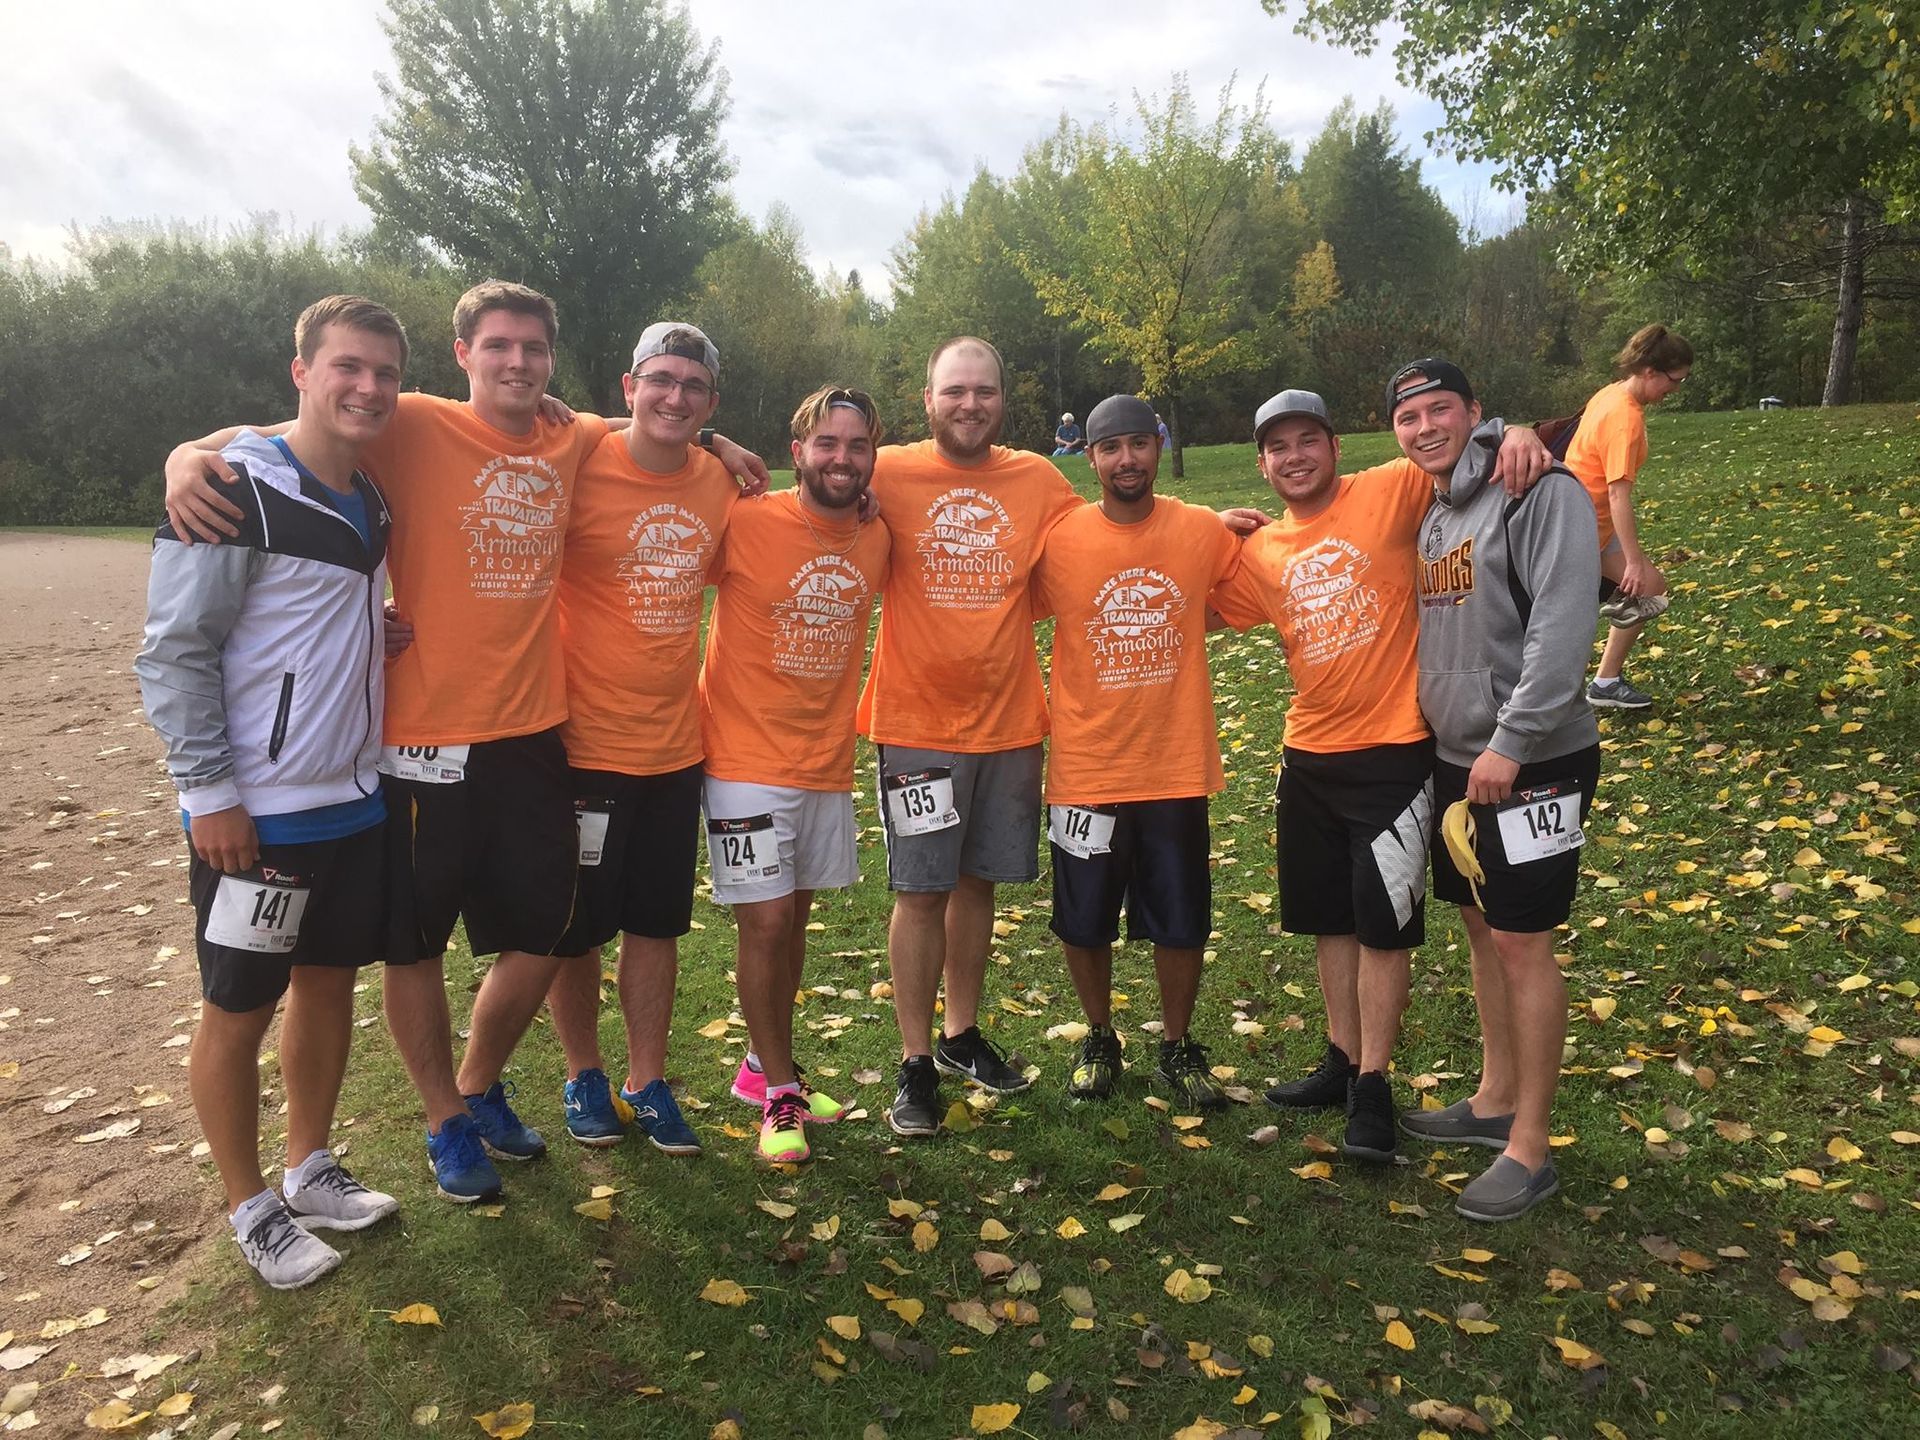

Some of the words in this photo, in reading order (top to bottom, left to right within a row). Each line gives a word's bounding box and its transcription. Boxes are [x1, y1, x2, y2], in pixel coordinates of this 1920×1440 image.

[473, 457, 505, 487] MAKE
[484, 498, 554, 526] TRAVATHON
[927, 493, 951, 518] MAKE
[950, 488, 976, 498] HERE
[977, 491, 1010, 523] MATTER
[627, 511, 650, 540] MAKE
[649, 504, 677, 517] HERE
[679, 507, 712, 542] MATTER
[935, 526, 996, 547] TRAVATHON
[470, 557, 541, 570] PROJE
[637, 548, 700, 567] TRAVATHON
[921, 551, 1014, 574] Armadillo
[474, 573, 521, 581] SEPTEMBER
[788, 560, 815, 589] MAKE
[816, 555, 841, 567] HERE
[842, 559, 868, 594] MATTER
[923, 573, 1012, 585] PROJECT
[1093, 577, 1118, 606] MAKE
[1118, 567, 1146, 581] HERE
[1147, 569, 1182, 599] MATTER
[1292, 574, 1354, 601] TRAVATHON
[926, 586, 967, 594] SEPTEMBER
[796, 596, 855, 617] TRAVATHON
[1102, 610, 1167, 625] TRAVATHON
[1293, 585, 1378, 635] Armadillo
[774, 640, 849, 655] PROJEC
[1092, 626, 1184, 657] Armadillo
[1095, 648, 1182, 667] PROJECT
[1139, 668, 1178, 678] MINNESOTA
[901, 785, 936, 818] 135
[1065, 809, 1092, 841] 114
[1523, 802, 1566, 839] 142
[721, 835, 756, 867] 124
[250, 889, 292, 930] 141
